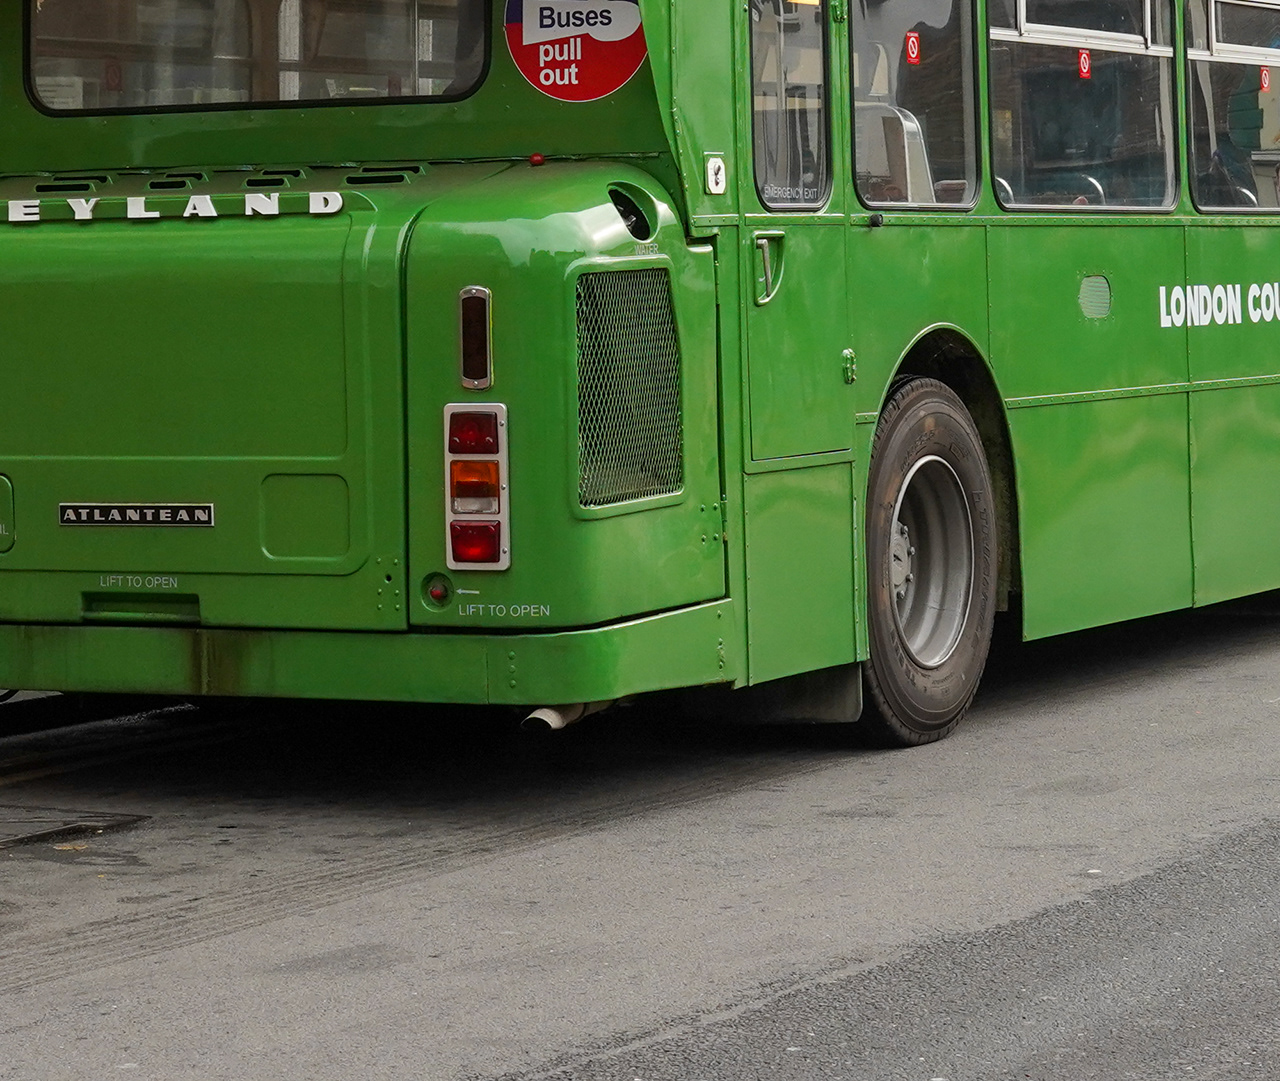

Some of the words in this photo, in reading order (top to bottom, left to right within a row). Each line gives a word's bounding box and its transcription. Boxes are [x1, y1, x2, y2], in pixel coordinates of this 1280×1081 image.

[539, 6, 612, 28] Buses
[539, 37, 582, 67] pull
[539, 63, 579, 85] out
[764, 184, 802, 199] EMERGENCY
[804, 187, 818, 199] EXIT
[634, 243, 659, 256] WATER
[1159, 284, 1242, 327] LONDON
[63, 508, 209, 521] ATLANTEAN
[100, 575, 123, 587] LIFT
[126, 575, 142, 587] TO
[145, 576, 178, 588] OPEN
[459, 605, 485, 616] LIFT
[488, 605, 506, 617] TO
[510, 605, 550, 617] OPEN
